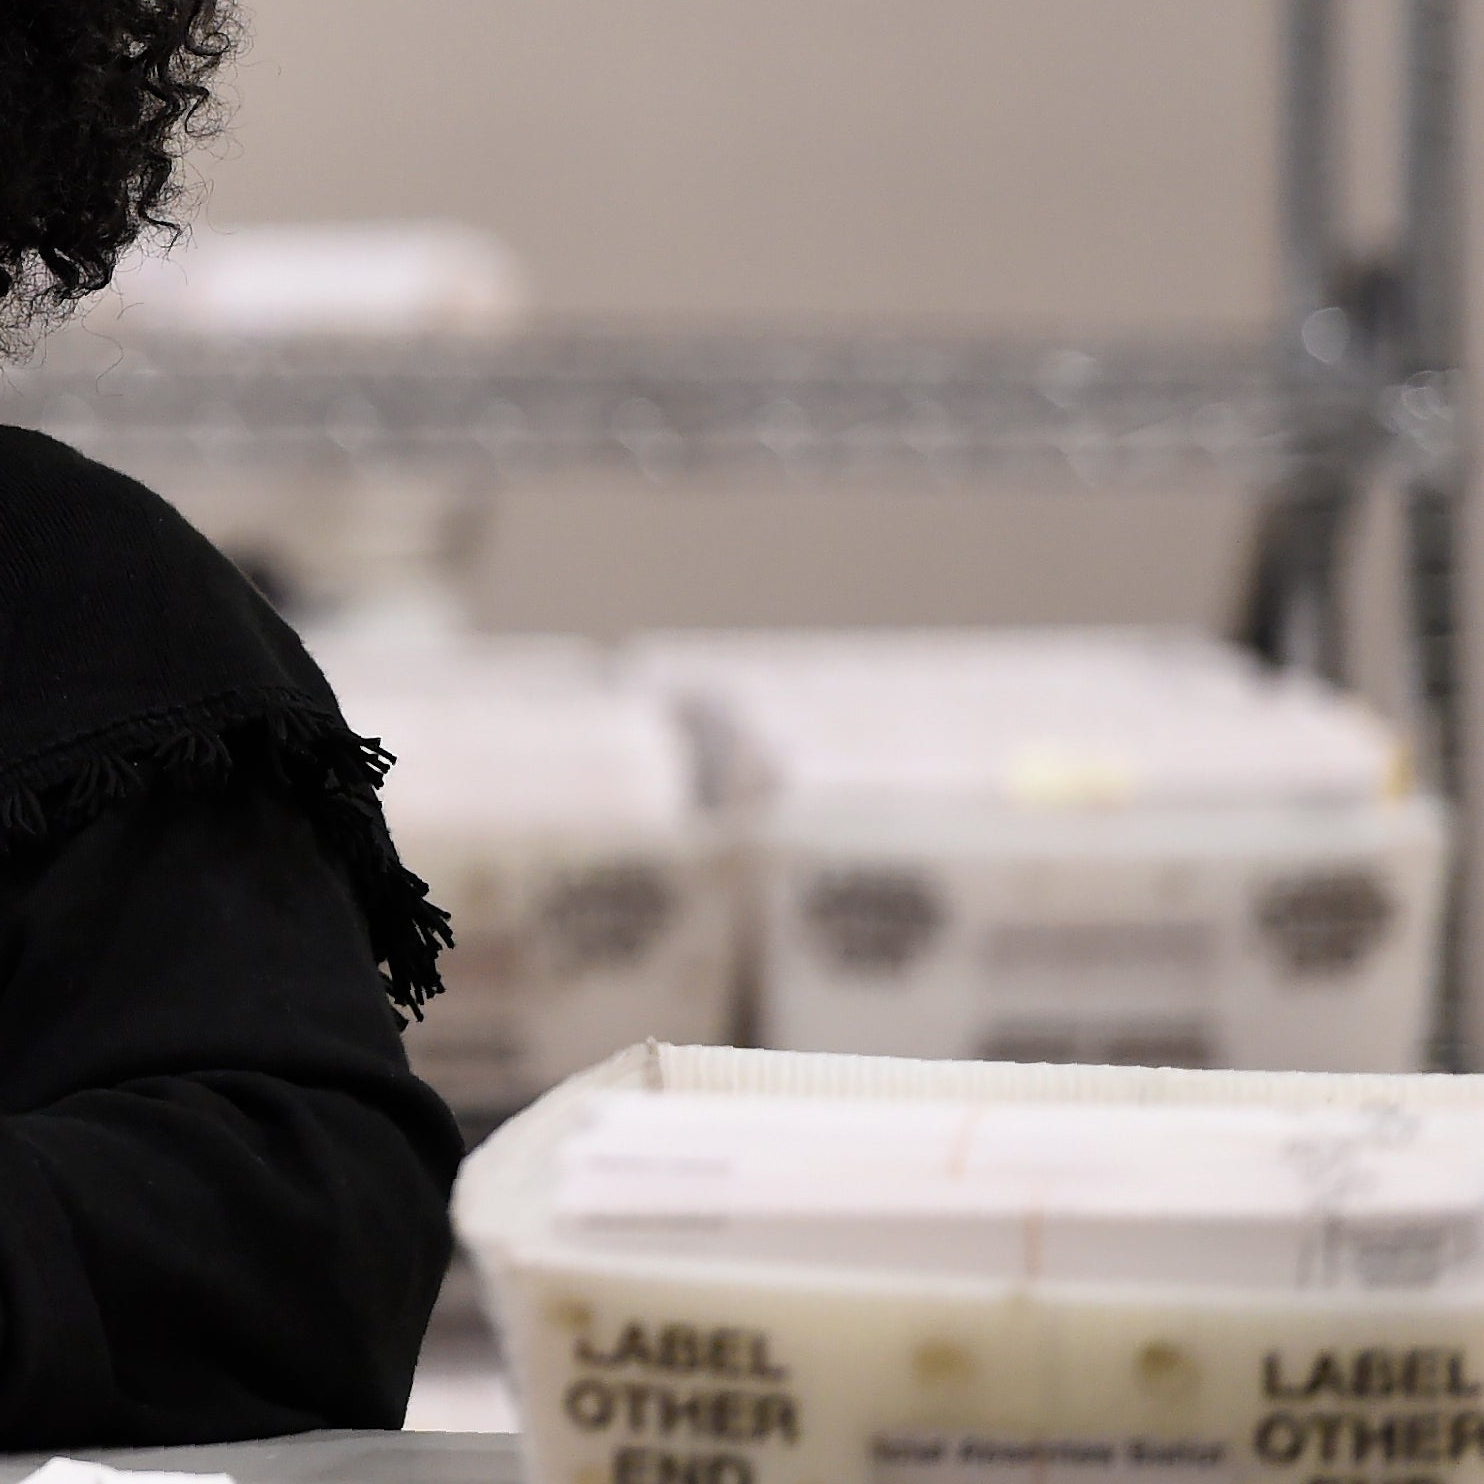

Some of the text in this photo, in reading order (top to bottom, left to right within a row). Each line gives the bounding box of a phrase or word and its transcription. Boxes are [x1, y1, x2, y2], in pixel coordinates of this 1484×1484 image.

[574, 1320, 790, 1384] LABEL
[1261, 1345, 1482, 1400] LABEL
[562, 1377, 802, 1447] OTHER
[610, 1445, 758, 1484] END
